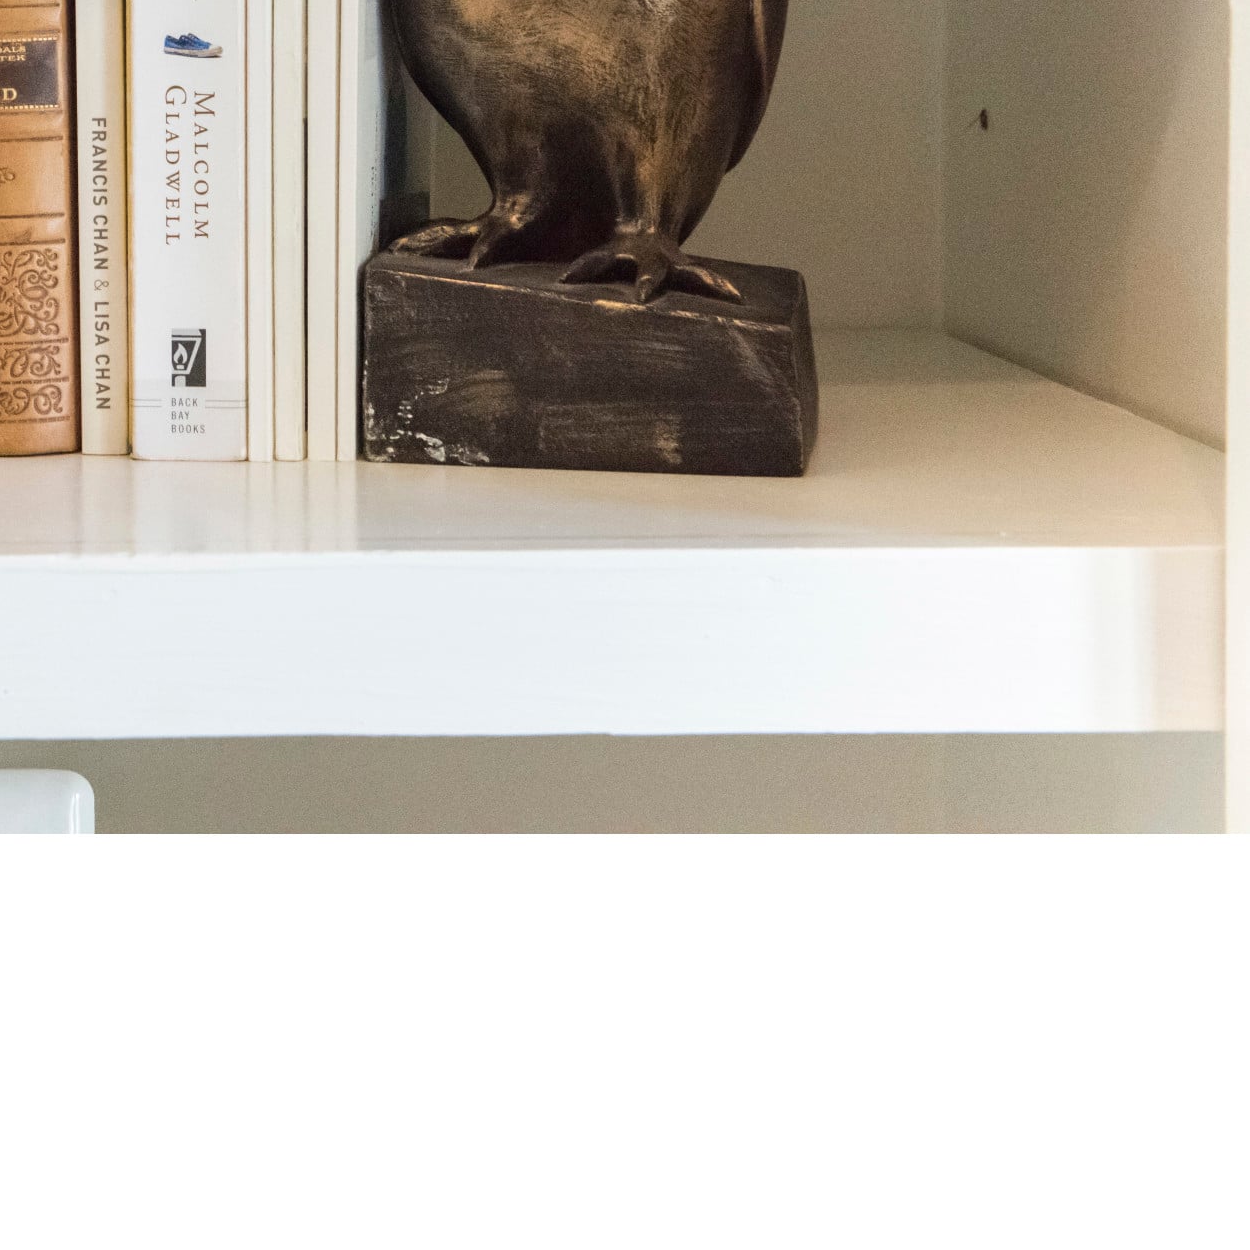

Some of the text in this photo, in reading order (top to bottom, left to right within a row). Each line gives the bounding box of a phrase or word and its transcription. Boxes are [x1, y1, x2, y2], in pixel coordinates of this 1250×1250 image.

[165, 85, 187, 246] GLADWELL
[193, 91, 216, 239] MALCOLM
[91, 117, 111, 410] FRANCIS CHAN & LISA CHAN
[171, 398, 198, 407] BACK
[171, 411, 190, 420] BAY
[171, 425, 206, 434] BOOKS
